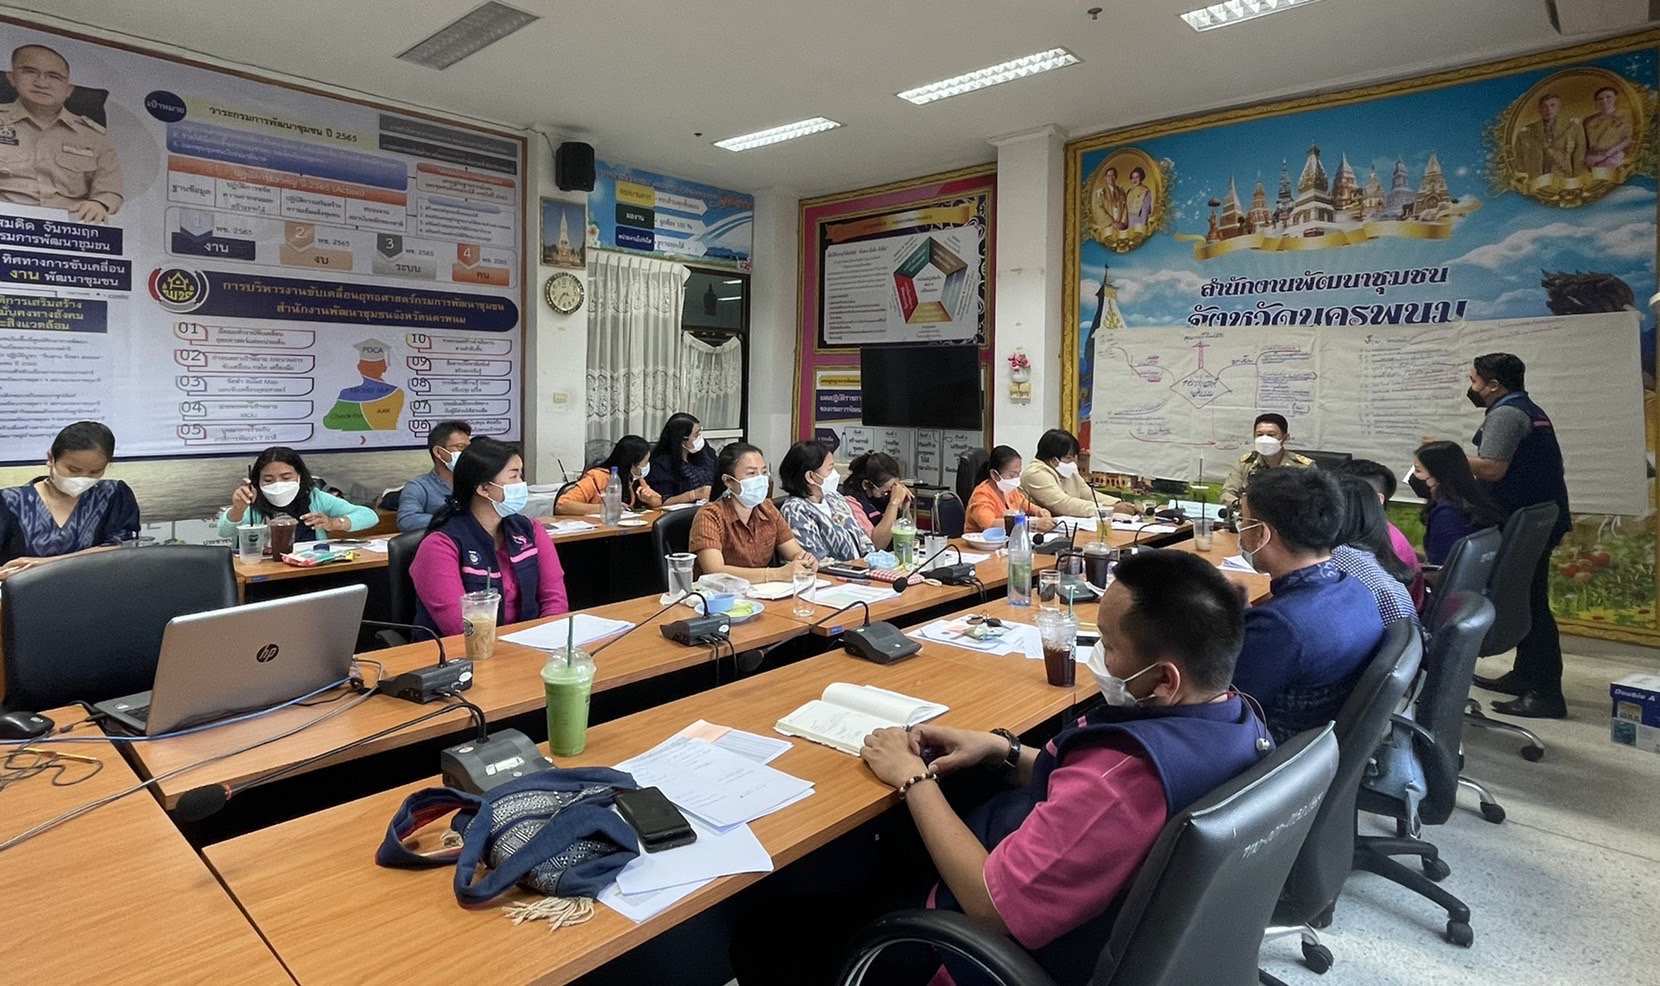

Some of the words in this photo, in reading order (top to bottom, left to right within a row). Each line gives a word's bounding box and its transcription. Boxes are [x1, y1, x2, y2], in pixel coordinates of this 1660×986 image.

[209, 106, 323, 136] วาระกรมการพัฒนาชุมชน
[325, 127, 333, 138] ปี
[336, 131, 358, 143] 2565
[172, 184, 211, 197] ฐานข้อมูล
[332, 184, 366, 197] (Action)
[43, 221, 99, 238] จันทมฤก
[295, 226, 307, 239] 2
[204, 242, 229, 253] งาน
[333, 239, 351, 247] 2565
[386, 238, 394, 249] 3
[418, 249, 434, 257] 2565
[463, 247, 471, 259] 4
[1, 253, 126, 274] ทิศทางการขับเคลื่อน
[314, 256, 329, 265] งบ
[395, 263, 421, 273] ระบบ
[9, 269, 40, 281] งาน
[44, 270, 119, 287] พัฒนาชุมชน
[476, 271, 490, 279] คน
[1200, 265, 1449, 295] สำนักงานพัฒนาชุมชน
[223, 280, 505, 312] การบริหารงานขับเคลื่อนยุทธศาสตร์กรมการพัฒนาชุมชน
[276, 301, 466, 324] สำนักงานพัฒนาชุมชนจังหวัดนครพนม
[1187, 300, 1468, 328] จังหวัดนครพนม
[178, 321, 198, 335] 01
[411, 334, 426, 344] 10
[180, 349, 201, 361] 02
[362, 346, 384, 354] PDCA
[411, 357, 427, 367] 09
[179, 375, 201, 387] 03
[411, 378, 427, 388] 08
[181, 401, 202, 413] 04
[412, 400, 429, 410] 07
[180, 423, 201, 435] 05
[412, 420, 427, 430] 06
[257, 644, 279, 662] hp
[1614, 688, 1646, 700] Double
[1648, 694, 1656, 702] A
